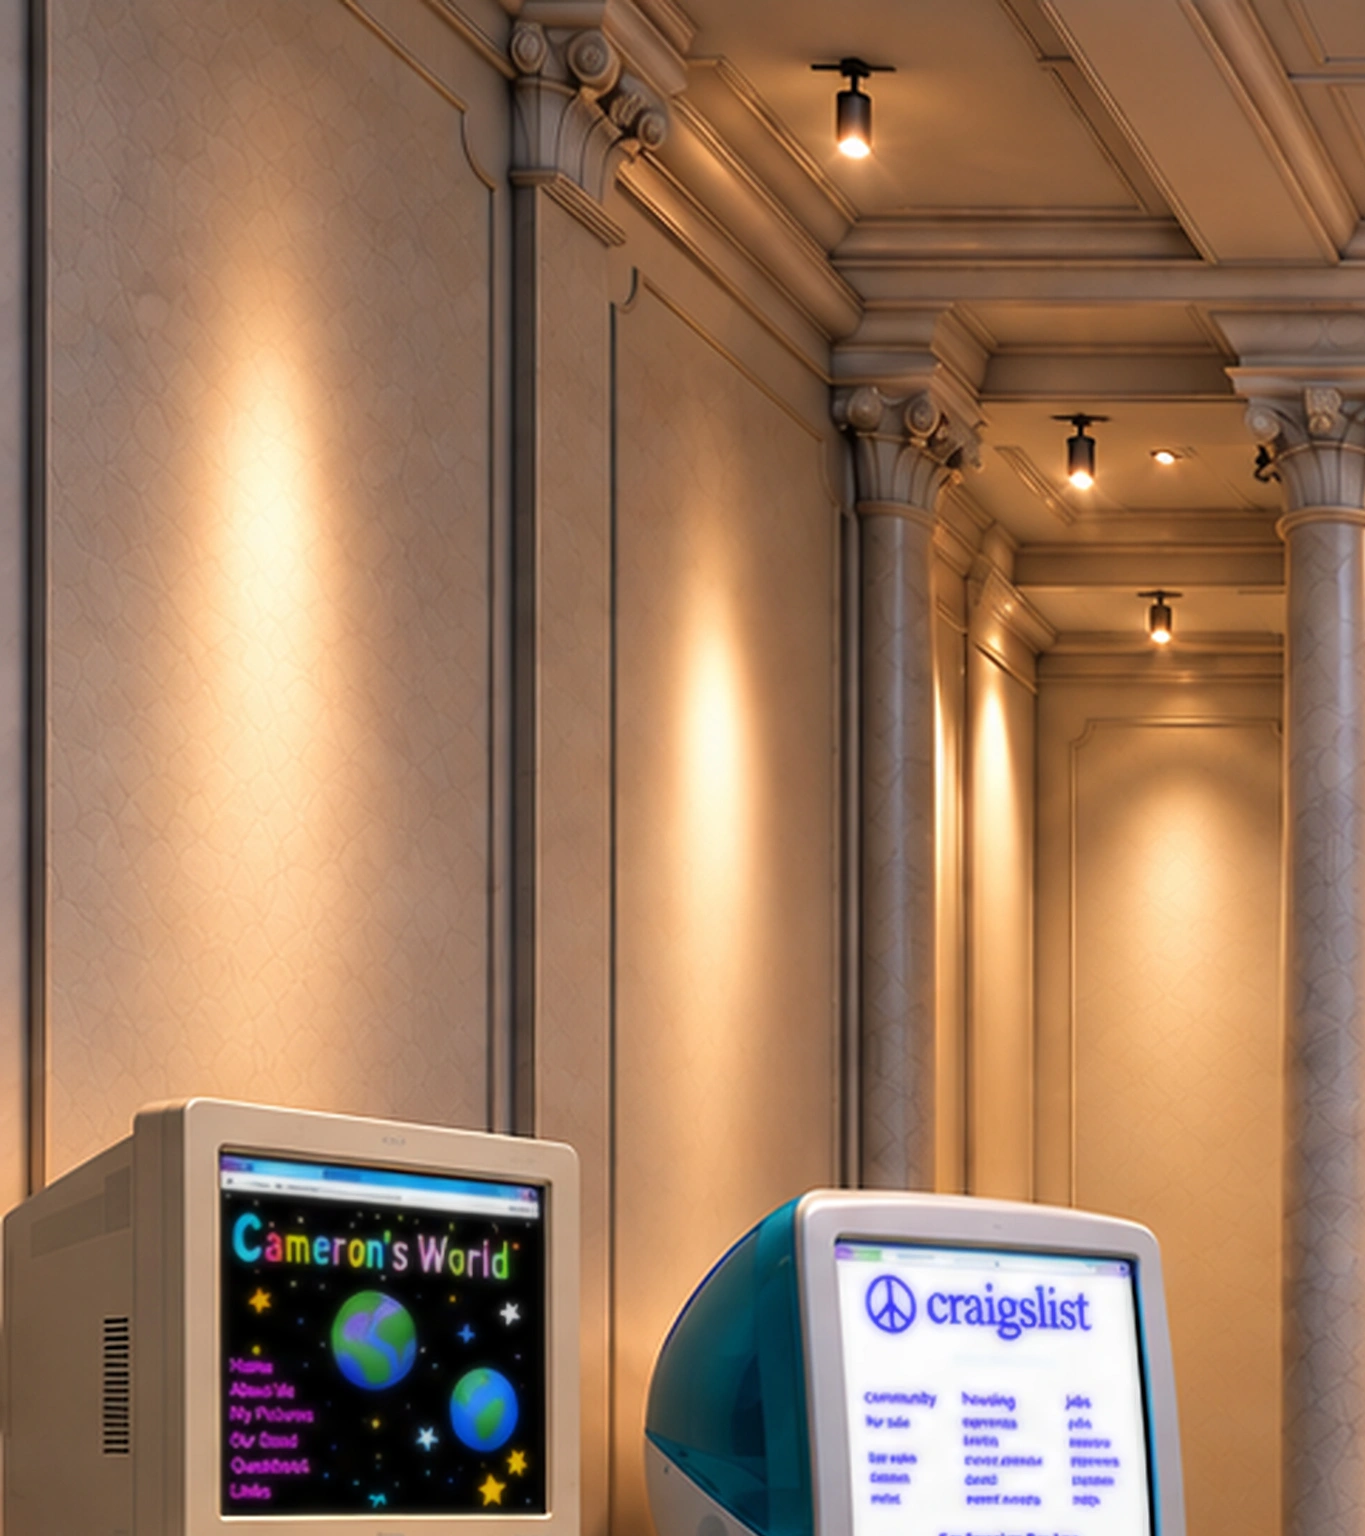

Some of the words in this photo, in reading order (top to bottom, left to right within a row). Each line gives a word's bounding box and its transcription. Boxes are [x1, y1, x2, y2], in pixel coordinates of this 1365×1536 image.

[233, 1213, 408, 1271] Cameron's
[418, 1234, 509, 1279] World
[926, 1283, 1091, 1341] craigslist
